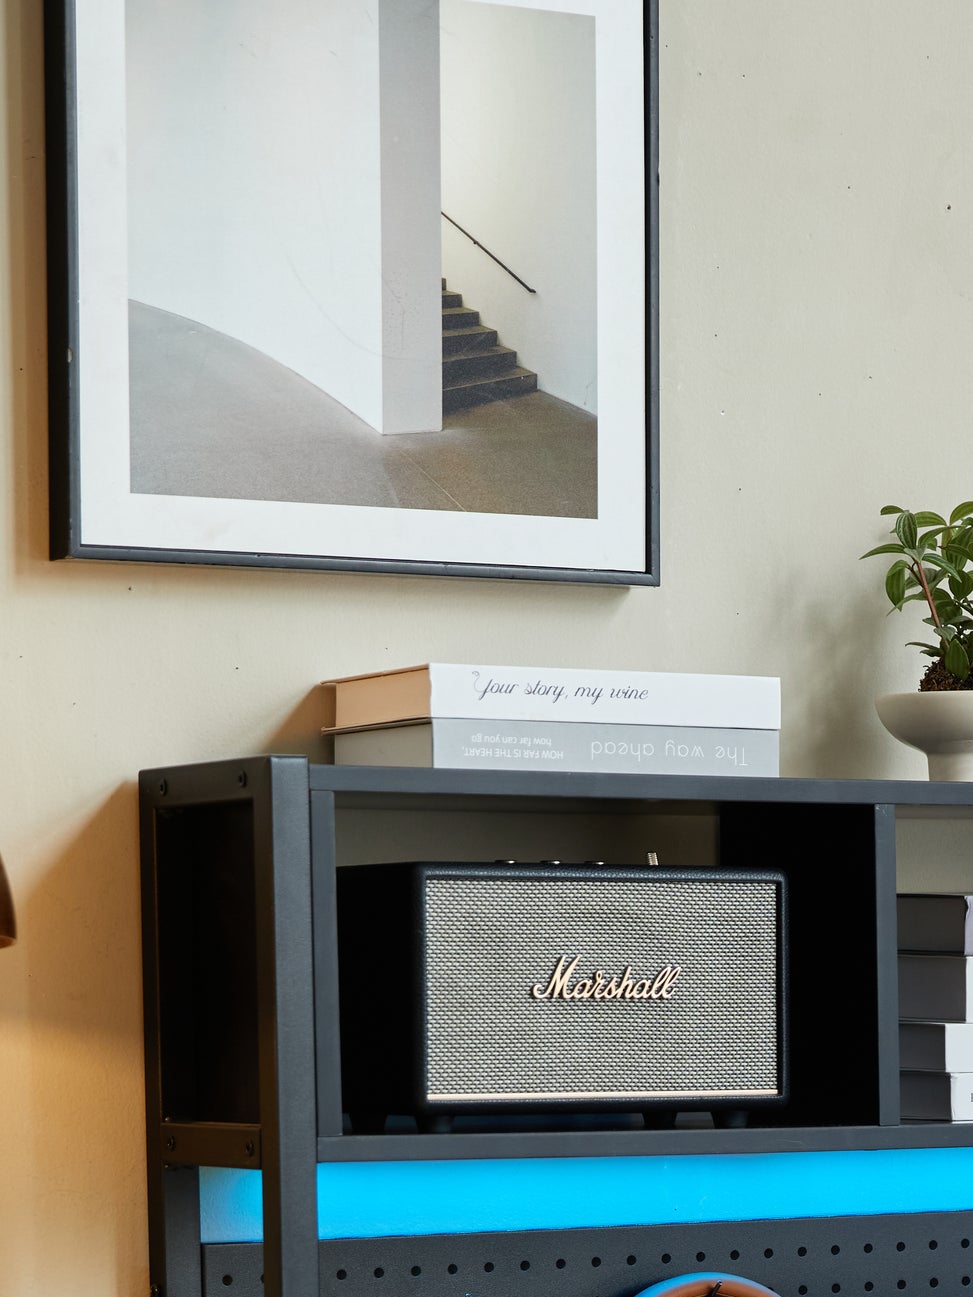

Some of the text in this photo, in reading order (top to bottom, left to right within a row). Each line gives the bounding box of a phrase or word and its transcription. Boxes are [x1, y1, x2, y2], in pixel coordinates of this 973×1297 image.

[472, 671, 649, 705] Your story, my wine
[471, 733, 552, 747] how far can you go
[494, 748, 513, 758] THE
[513, 748, 522, 758] IS
[523, 749, 541, 759] FAR
[540, 750, 564, 760] HOW
[591, 739, 748, 765] The way ahead
[532, 955, 681, 999] Marshall
